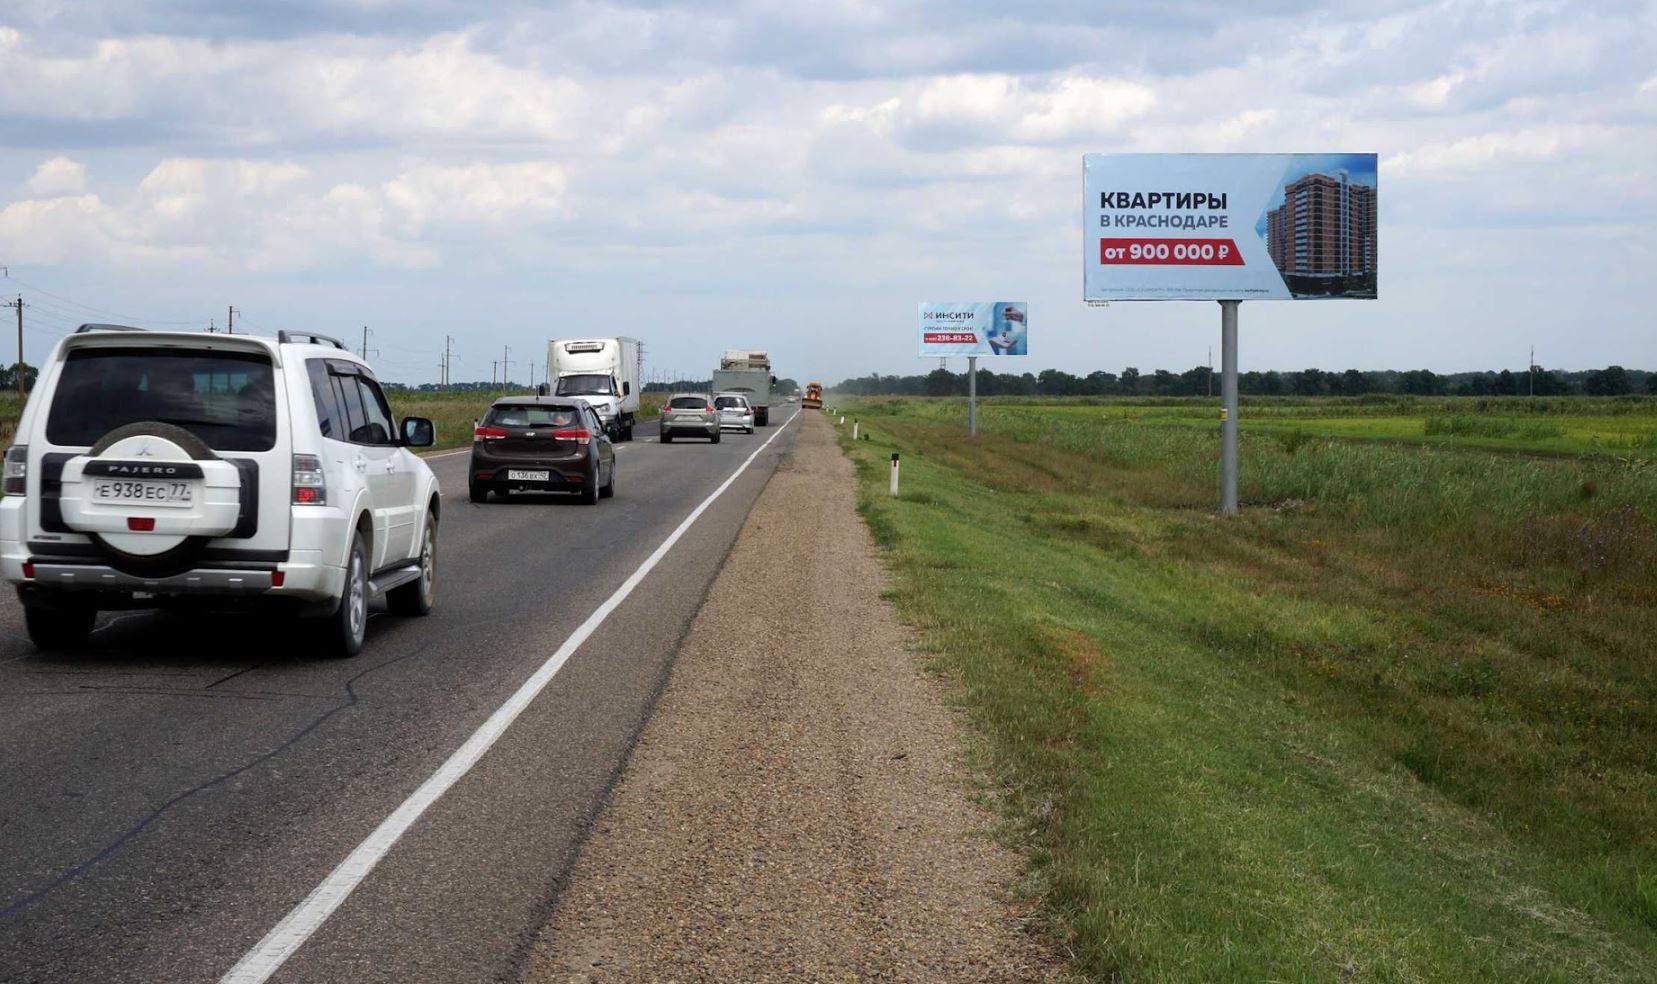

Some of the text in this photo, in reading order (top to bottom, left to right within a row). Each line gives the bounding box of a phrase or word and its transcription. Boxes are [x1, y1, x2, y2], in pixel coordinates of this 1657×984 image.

[1100, 192, 1227, 210] КВАРТИРЫ
[1100, 215, 1228, 230] В КРАСНОДАРЕ
[1104, 247, 1126, 259] от
[1129, 243, 1170, 260] 900
[1174, 243, 1214, 260] 000
[108, 465, 177, 474] PAJERO
[171, 483, 187, 496] 77
